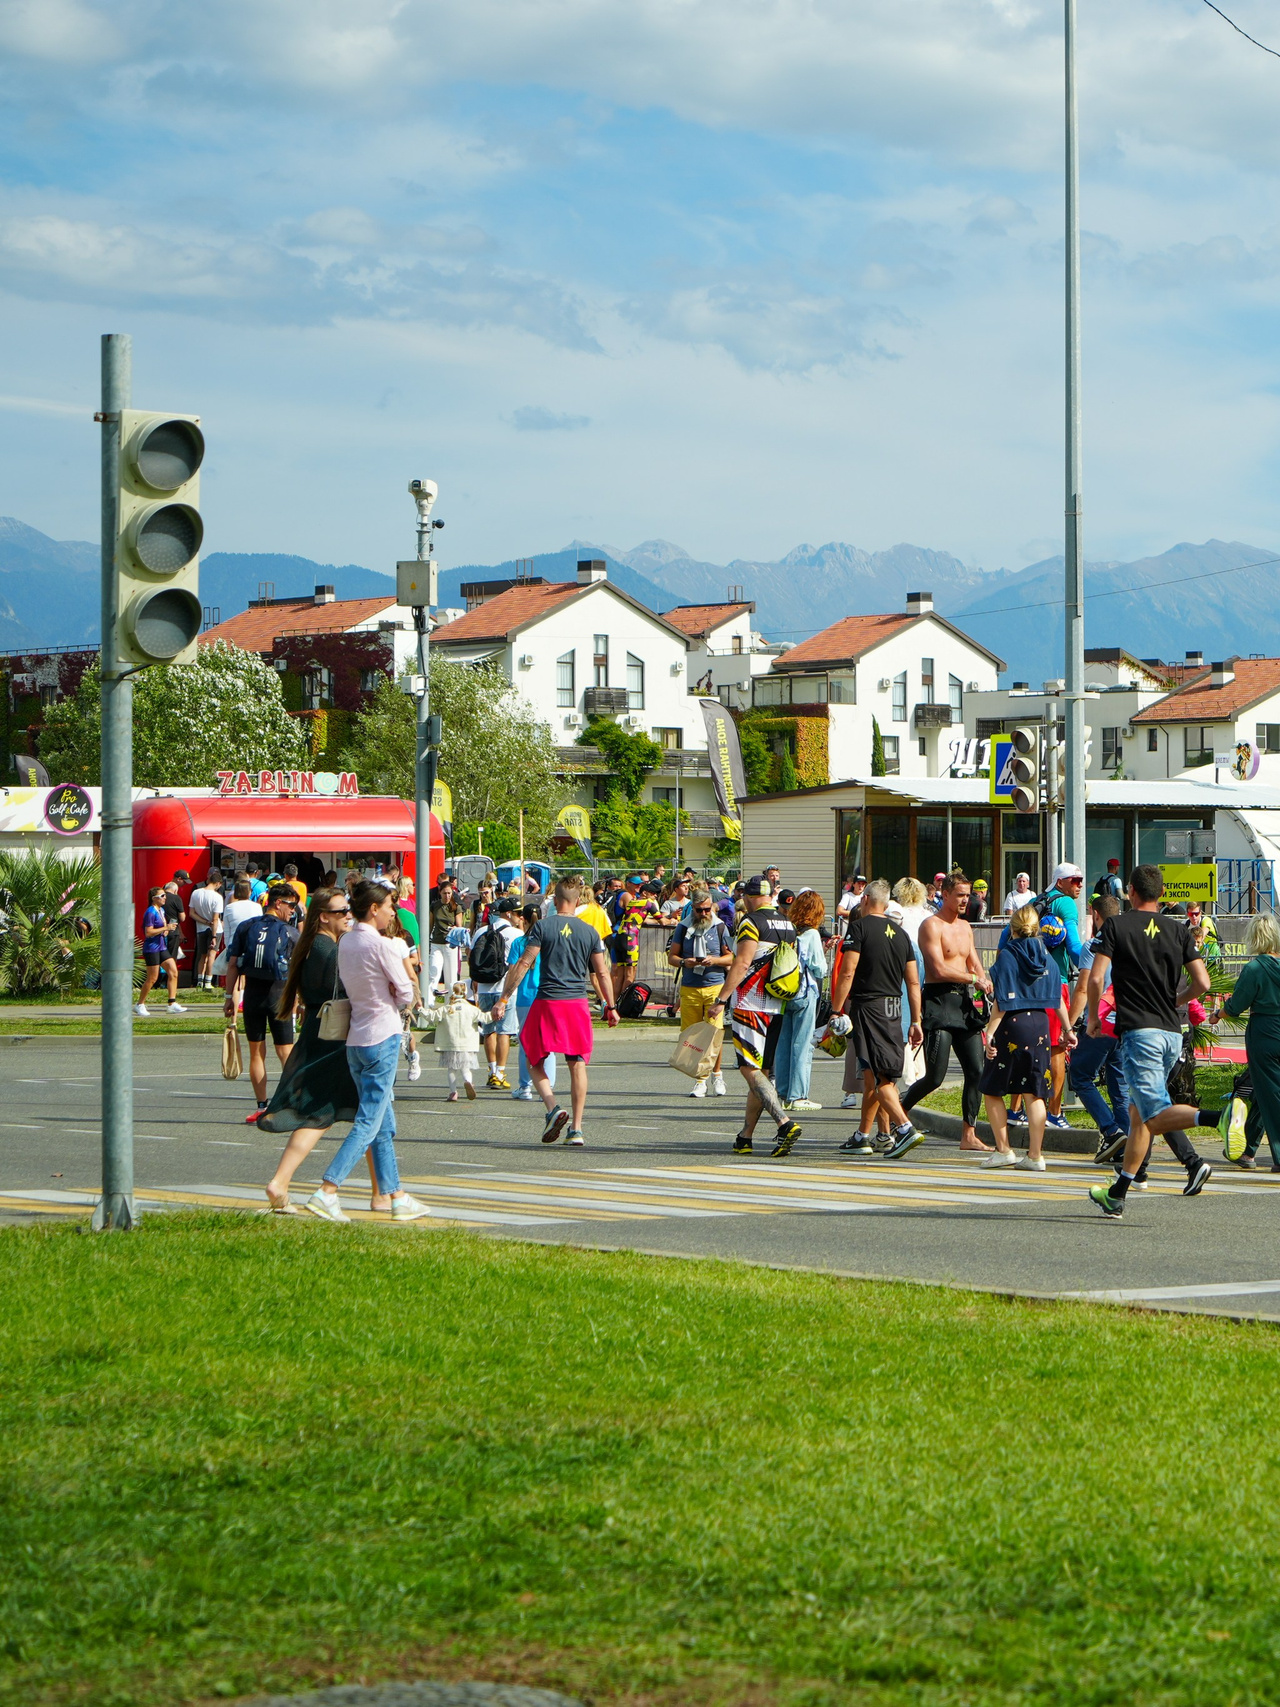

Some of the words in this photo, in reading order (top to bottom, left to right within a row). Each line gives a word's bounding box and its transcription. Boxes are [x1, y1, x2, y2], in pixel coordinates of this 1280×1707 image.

[217, 771, 252, 794] ZA
[1162, 882, 1209, 890] РЕГИСТРАЦИЯ
[1168, 890, 1190, 898] ЭКСПО
[654, 950, 674, 969] IRO
